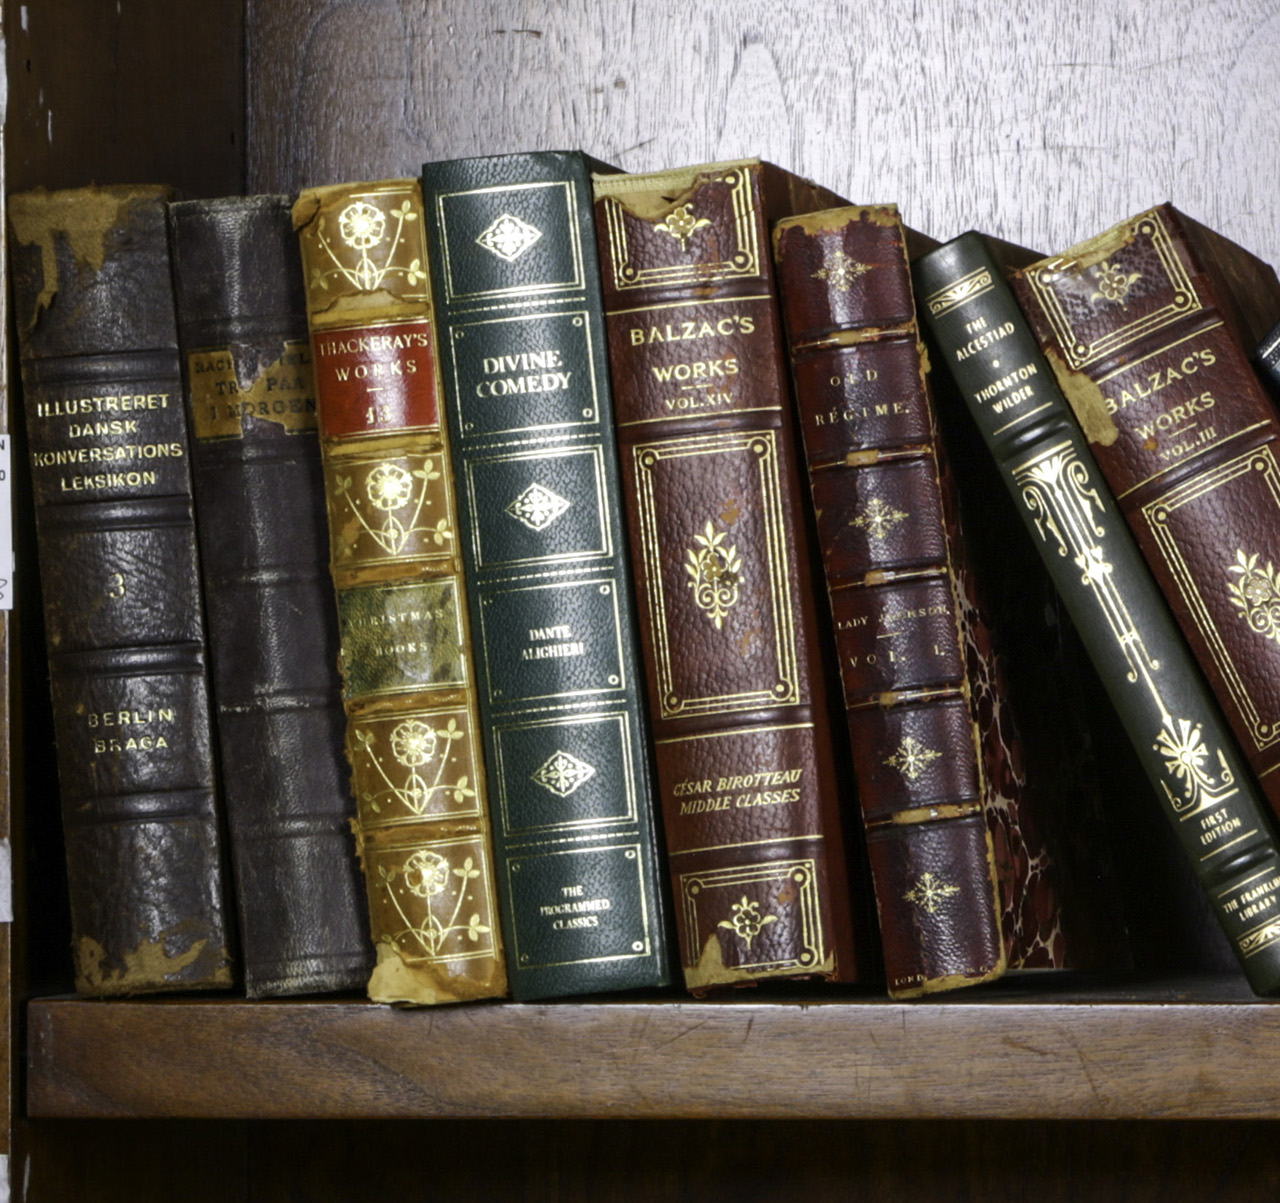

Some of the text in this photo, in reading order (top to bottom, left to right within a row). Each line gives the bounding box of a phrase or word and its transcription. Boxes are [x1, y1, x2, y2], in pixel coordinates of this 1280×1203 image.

[630, 315, 755, 346] BALZAC'S
[965, 316, 988, 334] THE
[319, 333, 428, 356] THACKERAY'S
[956, 322, 1014, 361] ALCESTIAD
[335, 359, 417, 382] WORKS
[483, 350, 563, 374] DIVINE
[652, 358, 739, 382] WORKS
[476, 372, 572, 398] COMEDY
[974, 363, 1037, 403] THORNTON
[1105, 349, 1216, 415] BALZAC'S
[38, 393, 170, 417] ILLUSTRERET
[992, 385, 1034, 414] WILDER
[1135, 391, 1215, 439] WORKS
[69, 420, 137, 438] DANSK
[34, 442, 183, 467] KONVERSATIONS
[61, 471, 156, 491] LEKSIKON
[110, 573, 125, 598] 3
[529, 625, 572, 641] DANTE
[522, 641, 584, 660] ALIGHIERI
[88, 708, 172, 728] BERLIN
[94, 737, 168, 753] BRAGA
[673, 769, 802, 797] CÉSAR BIROTTEAU
[680, 788, 800, 815] MIDDLE CLASSES
[1201, 808, 1228, 829] FIRST
[1200, 818, 1241, 845] EDITION
[561, 885, 584, 898] THE
[540, 898, 610, 916] PROGRAMMED
[1223, 899, 1239, 913] THE
[1239, 895, 1277, 921] LIBRARY
[552, 915, 599, 930] CLASSICS
